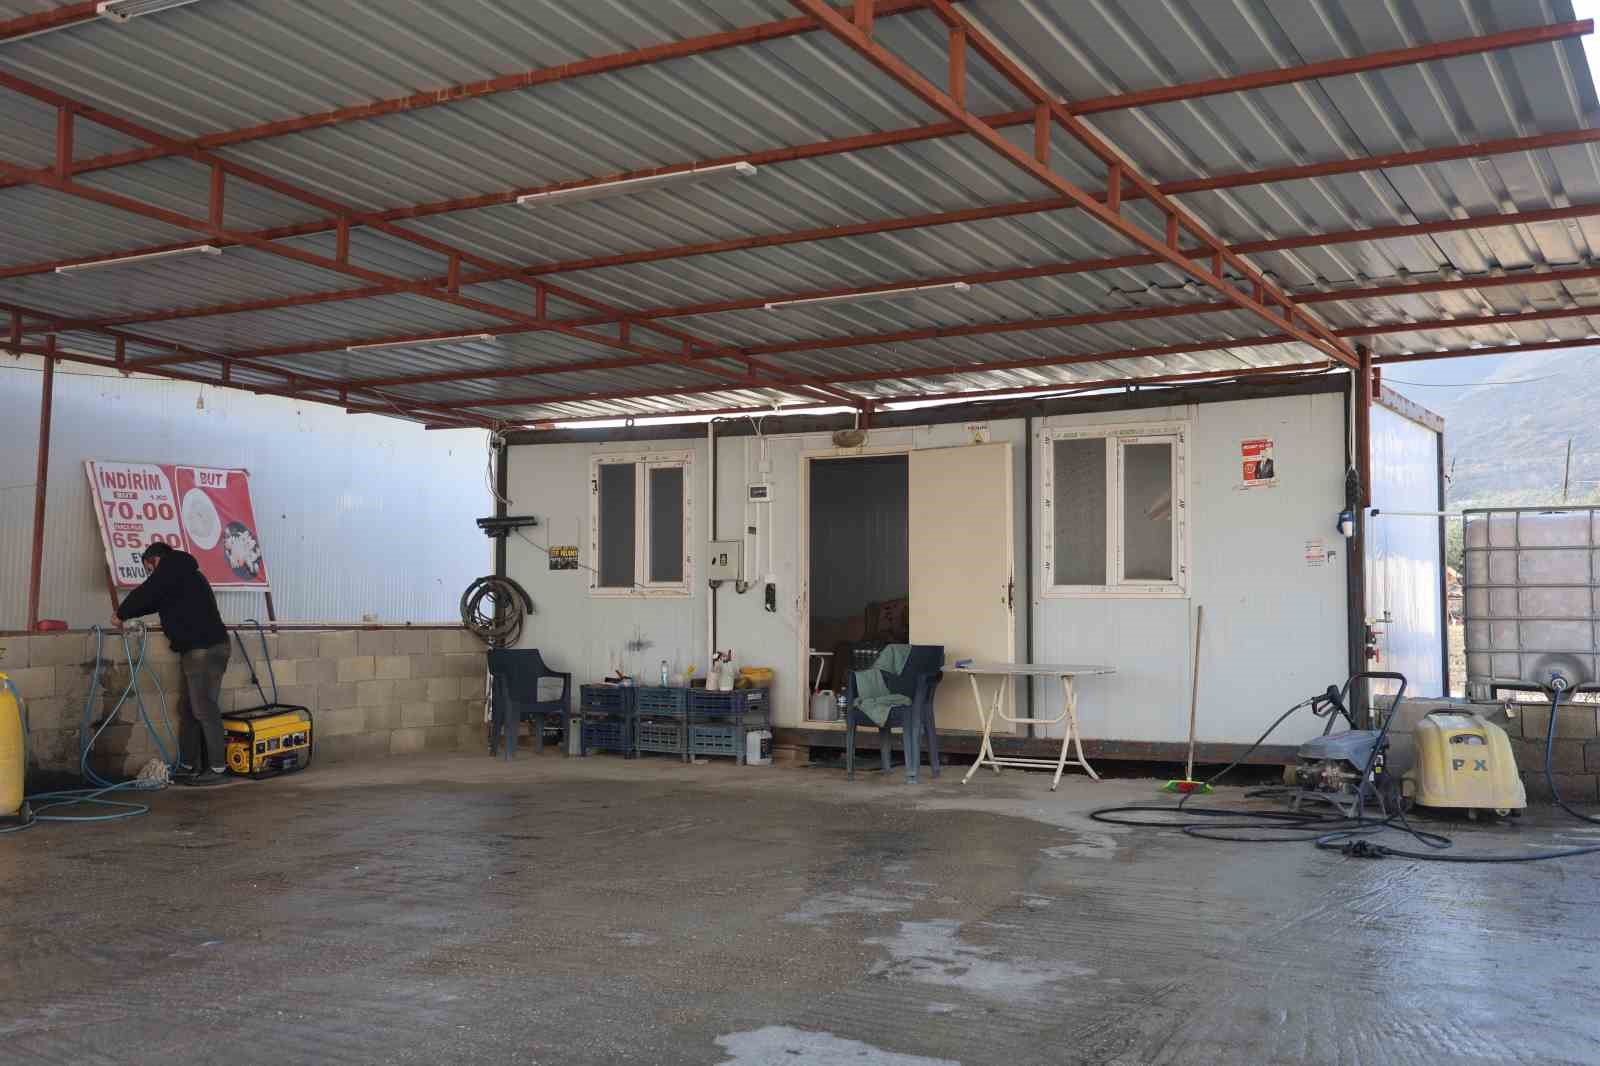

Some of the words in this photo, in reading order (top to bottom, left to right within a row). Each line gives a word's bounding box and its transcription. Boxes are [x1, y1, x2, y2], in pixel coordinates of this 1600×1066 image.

[100, 466, 162, 491] İNDİRİM
[199, 472, 223, 486] BUT
[103, 501, 174, 520] 70.00
